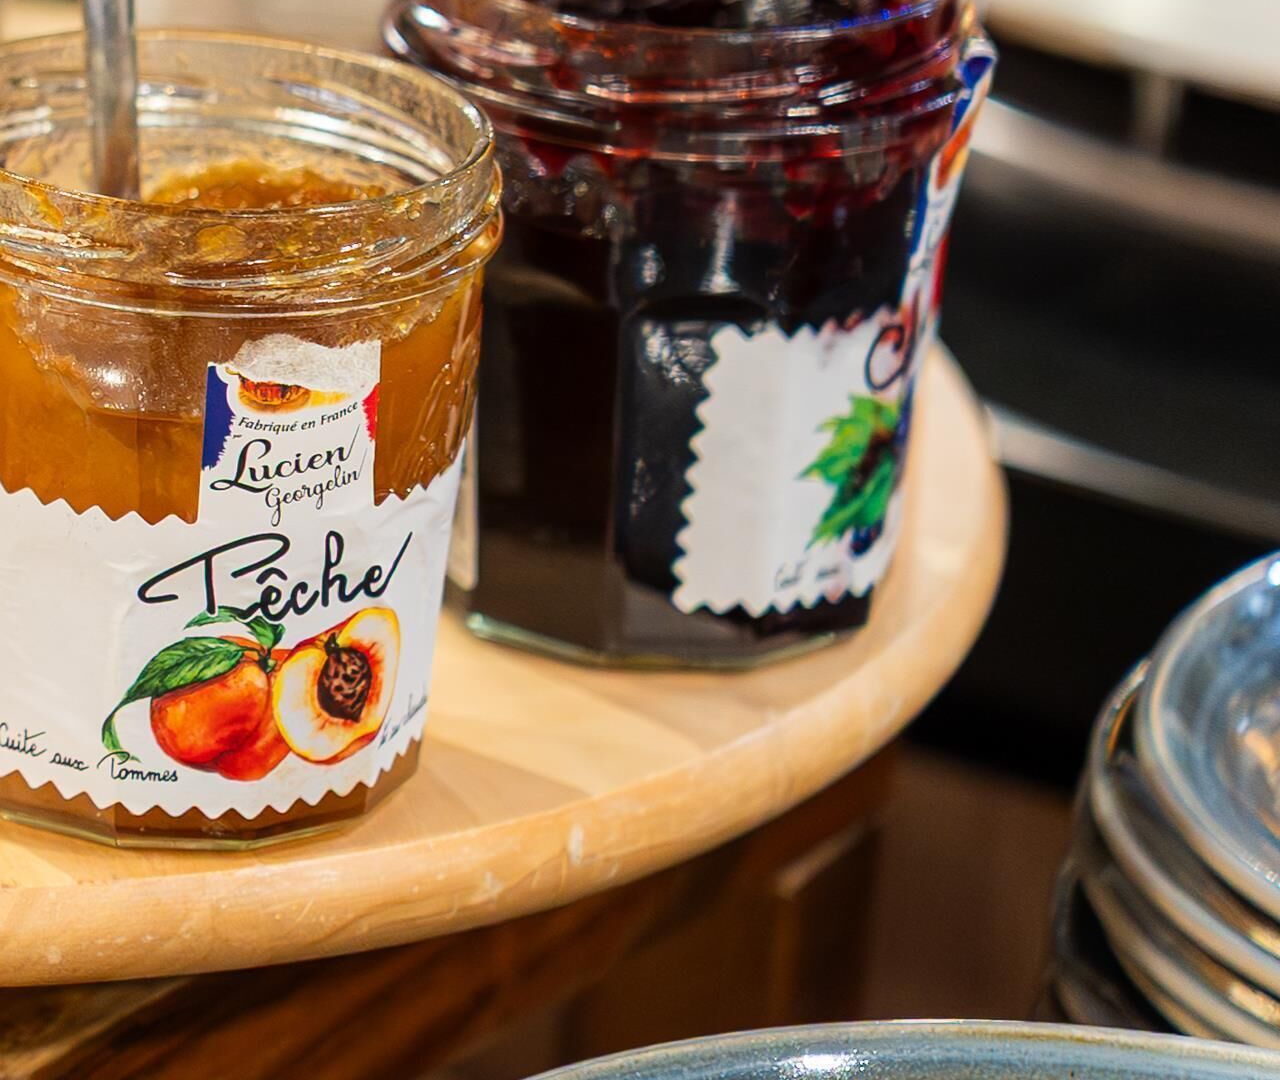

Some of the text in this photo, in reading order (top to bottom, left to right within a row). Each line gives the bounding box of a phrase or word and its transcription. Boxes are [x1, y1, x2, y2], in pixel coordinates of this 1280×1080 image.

[237, 401, 359, 435] Fabriqué en France
[209, 423, 361, 494] Lucien
[265, 447, 368, 527] Georgelin
[139, 530, 414, 623] Pêche
[49, 752, 90, 772] aux
[96, 750, 179, 783] Pommes
